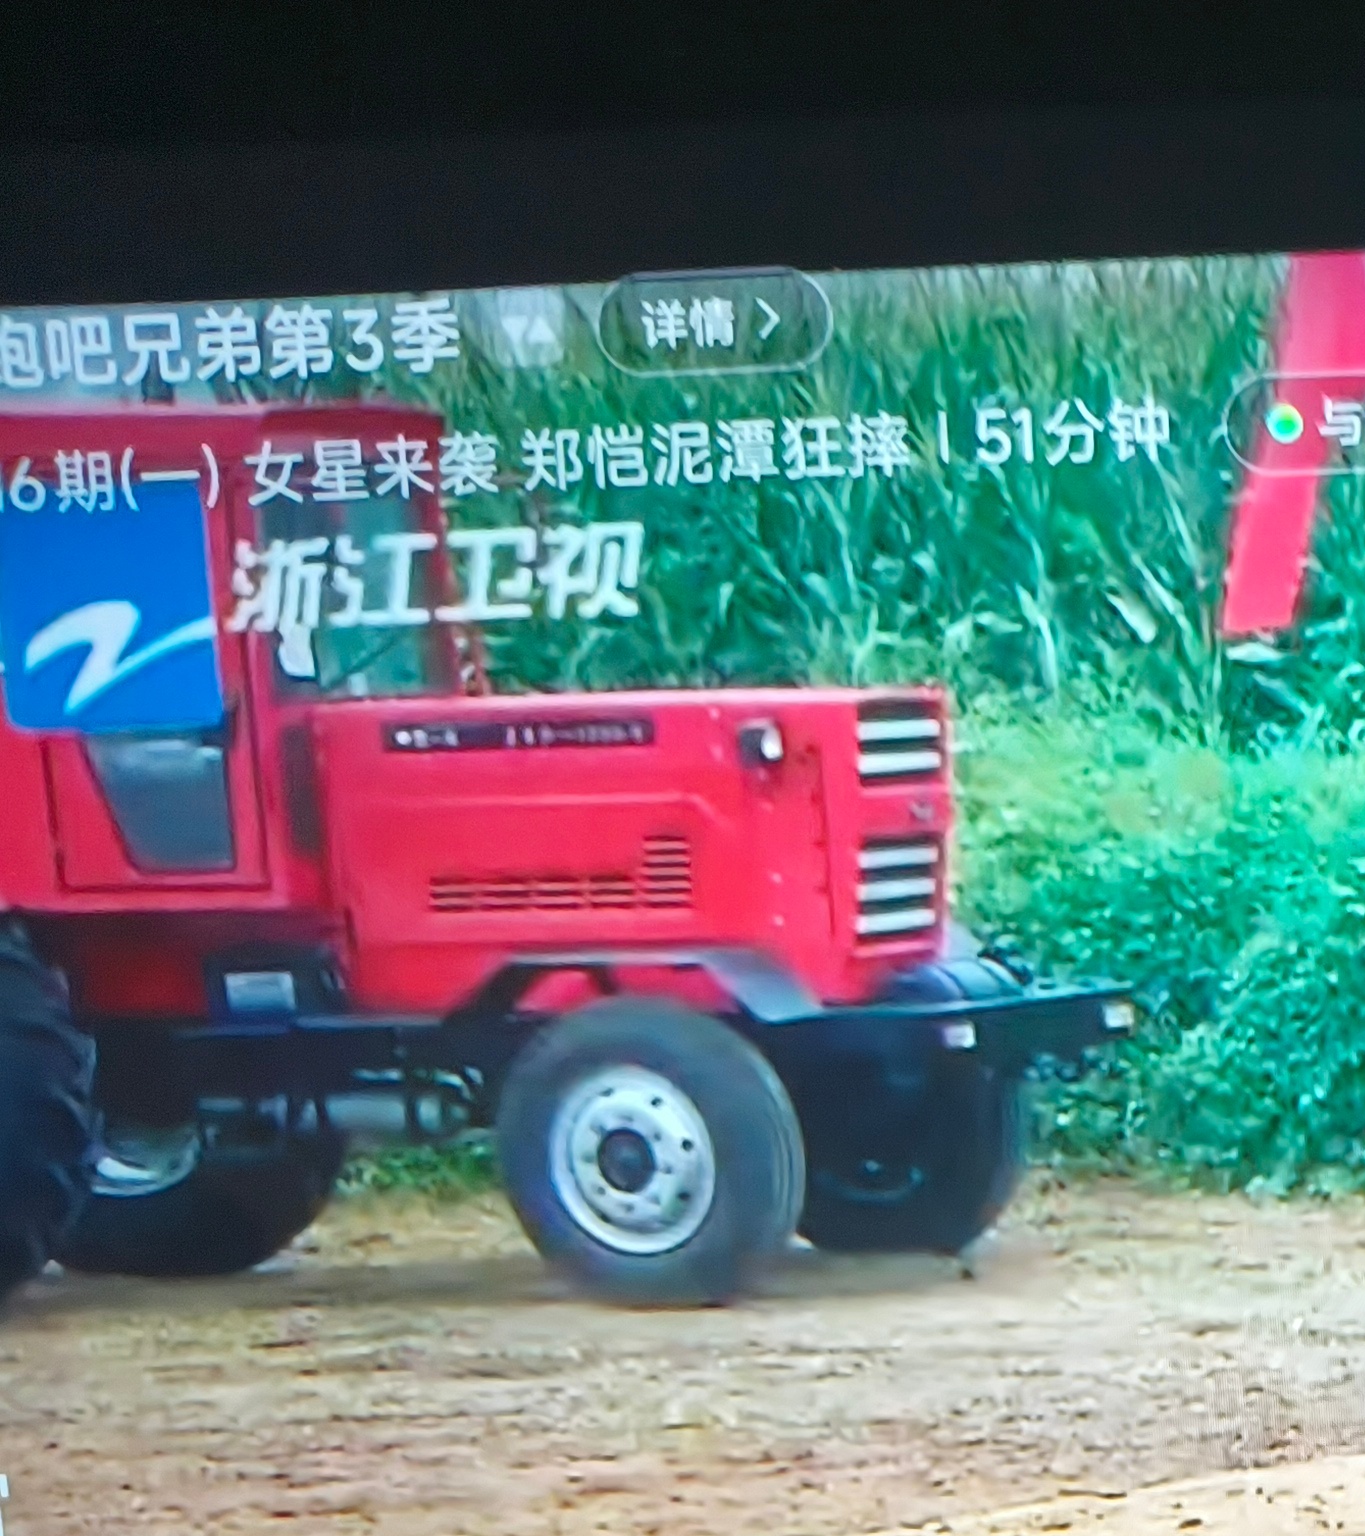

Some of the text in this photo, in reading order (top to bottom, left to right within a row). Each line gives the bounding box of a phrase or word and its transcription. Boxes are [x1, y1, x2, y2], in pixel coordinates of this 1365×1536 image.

[641, 297, 736, 350] 详情
[244, 432, 500, 506] 女星来袭
[522, 410, 912, 491] 郑恺泥潭狂摔
[975, 397, 1171, 466] 51分钟
[229, 521, 644, 677] 浙江卫视
